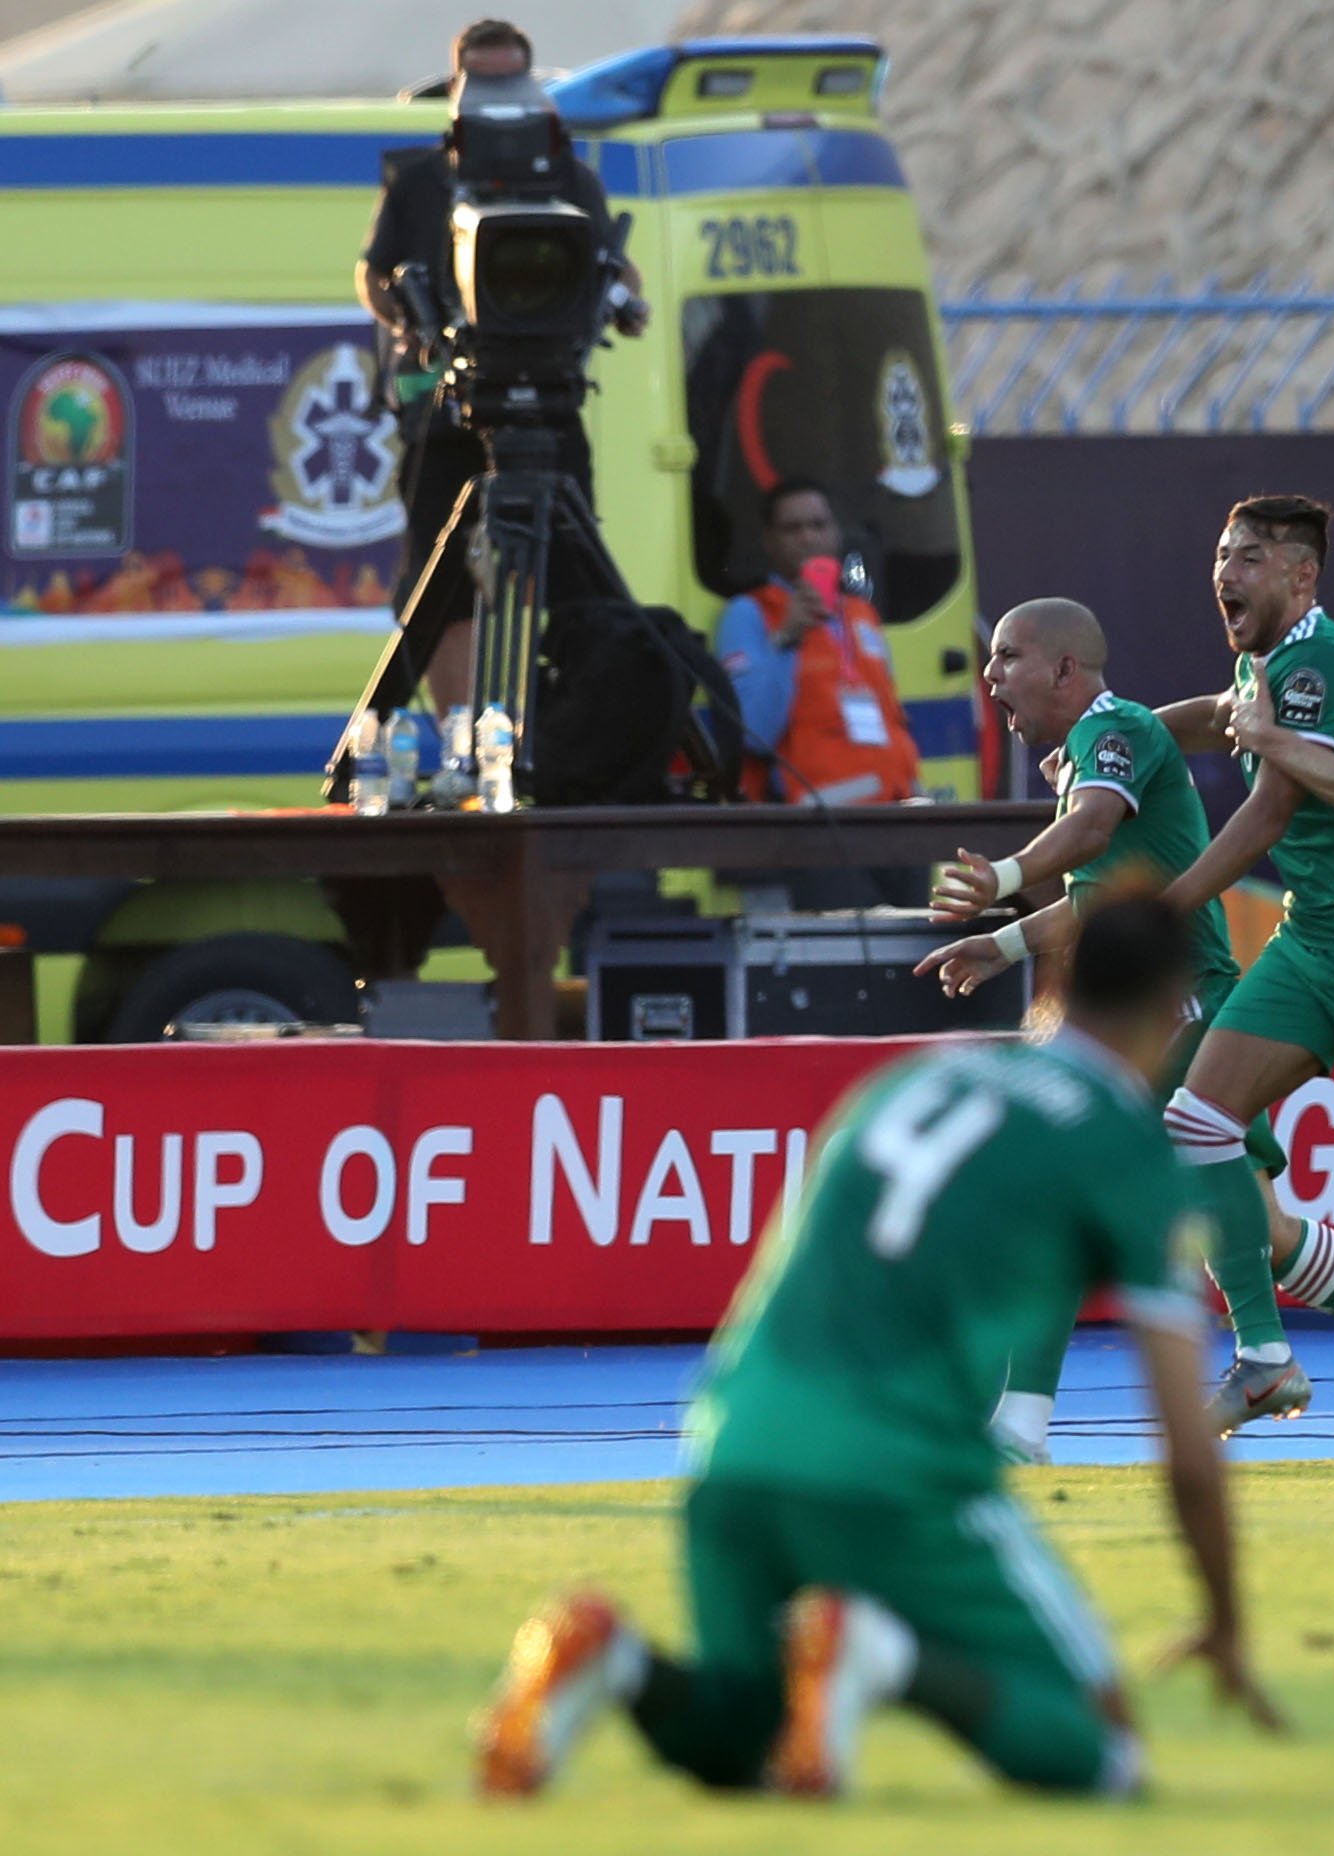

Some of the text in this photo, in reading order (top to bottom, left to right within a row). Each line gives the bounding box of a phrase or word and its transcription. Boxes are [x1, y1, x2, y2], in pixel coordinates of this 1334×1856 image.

[703, 217, 799, 279] 2962
[33, 466, 107, 493] CAF
[530, 1094, 810, 1246] NATI
[860, 1058, 1004, 1258] 4
